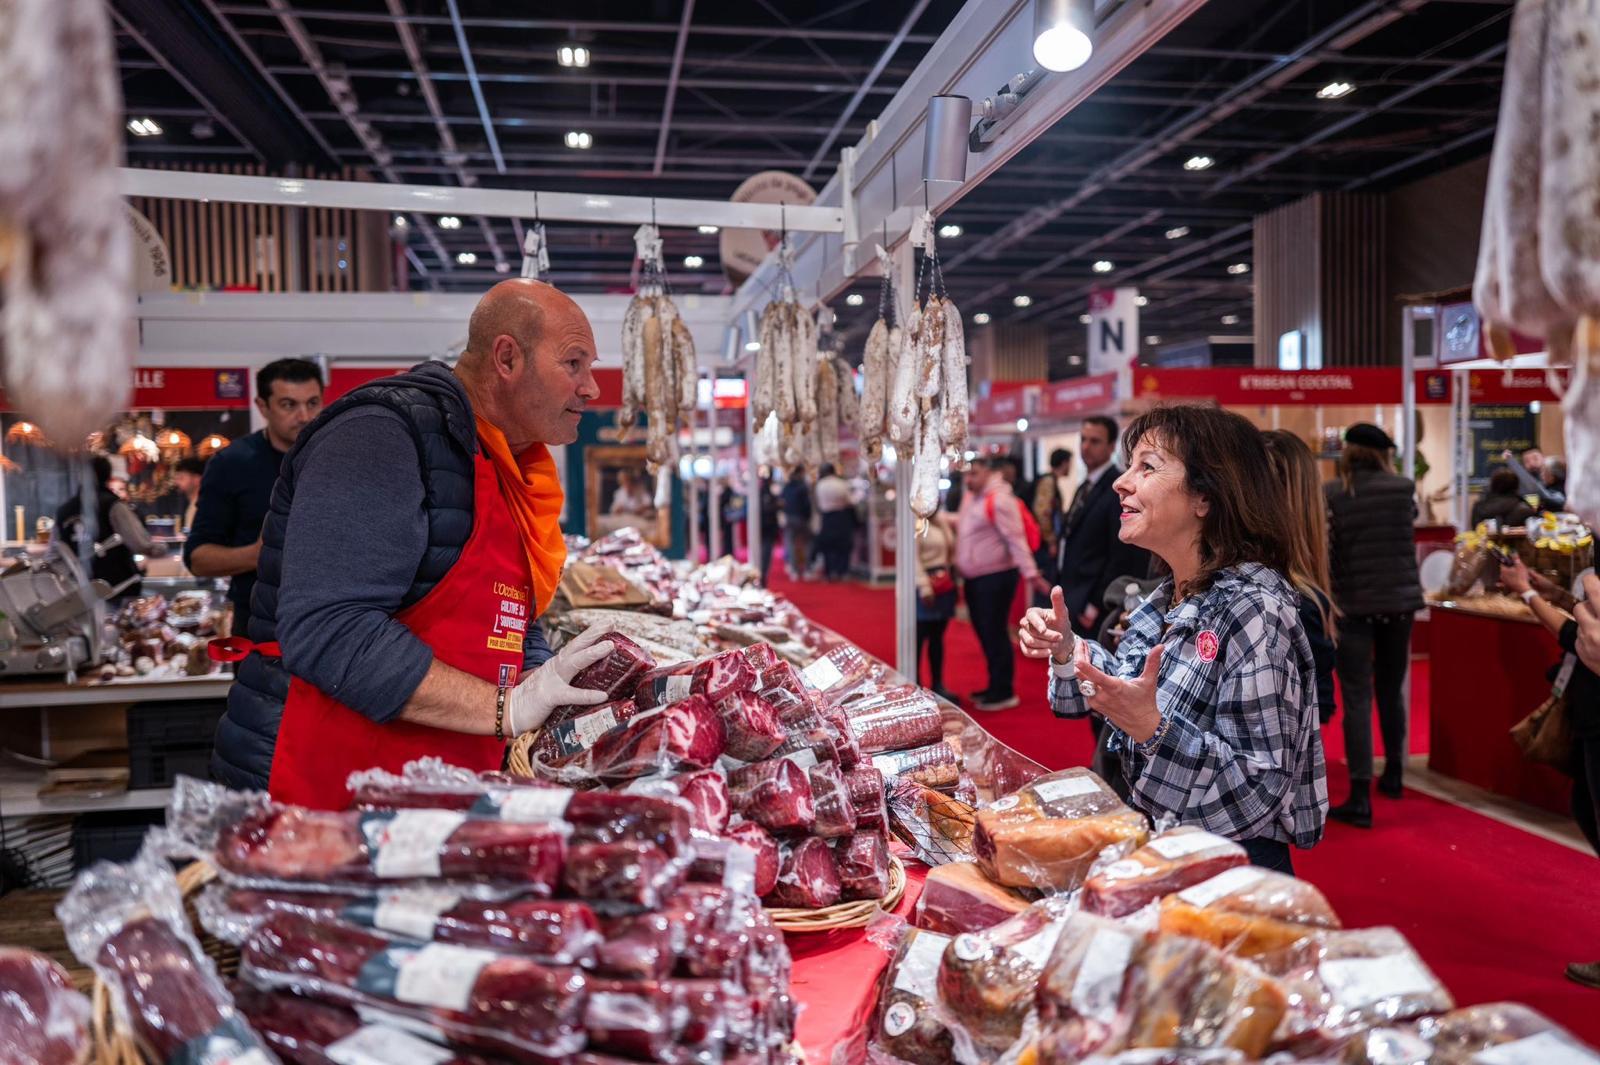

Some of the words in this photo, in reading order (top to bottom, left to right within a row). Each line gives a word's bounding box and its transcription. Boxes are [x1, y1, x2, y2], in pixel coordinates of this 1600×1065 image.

[1101, 319, 1124, 353] N
[134, 370, 164, 388] LLE
[1298, 374, 1353, 391] COCKTAIL
[500, 600, 519, 615] CULTIVE
